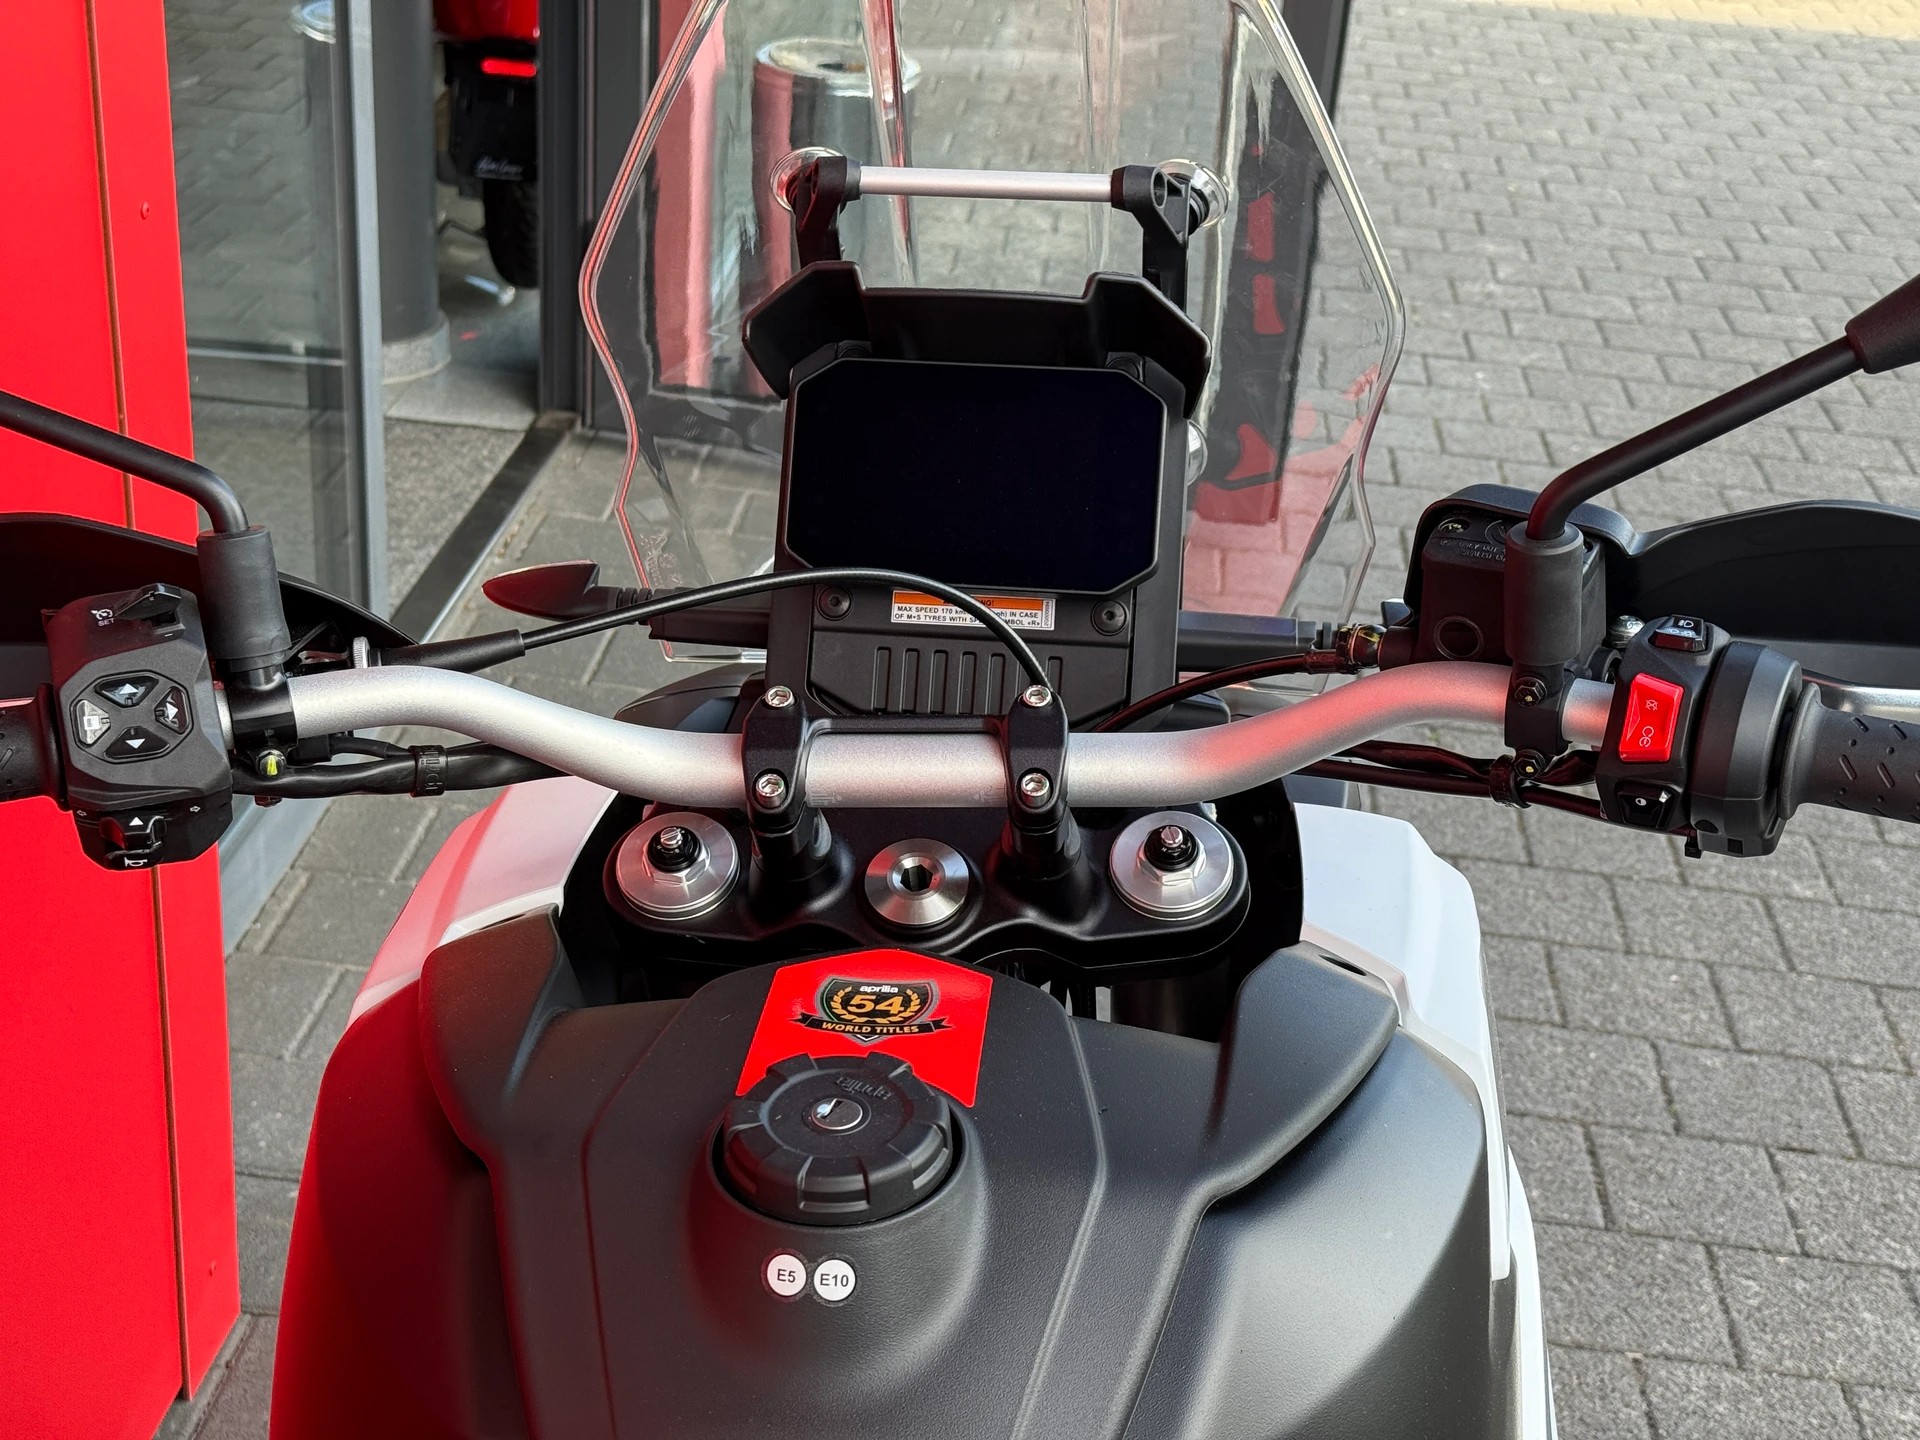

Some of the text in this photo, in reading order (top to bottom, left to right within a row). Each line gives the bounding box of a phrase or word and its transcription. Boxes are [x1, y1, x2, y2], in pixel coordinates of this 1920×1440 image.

[915, 606, 939, 614] SPEED
[1019, 611, 1039, 619] CASE
[924, 614, 946, 622] TYRES
[860, 984, 899, 993] aprilia
[847, 994, 905, 1014] 54
[821, 1021, 919, 1034] WORLD TITLES
[776, 1268, 796, 1284] E5
[819, 1273, 849, 1288] E10
